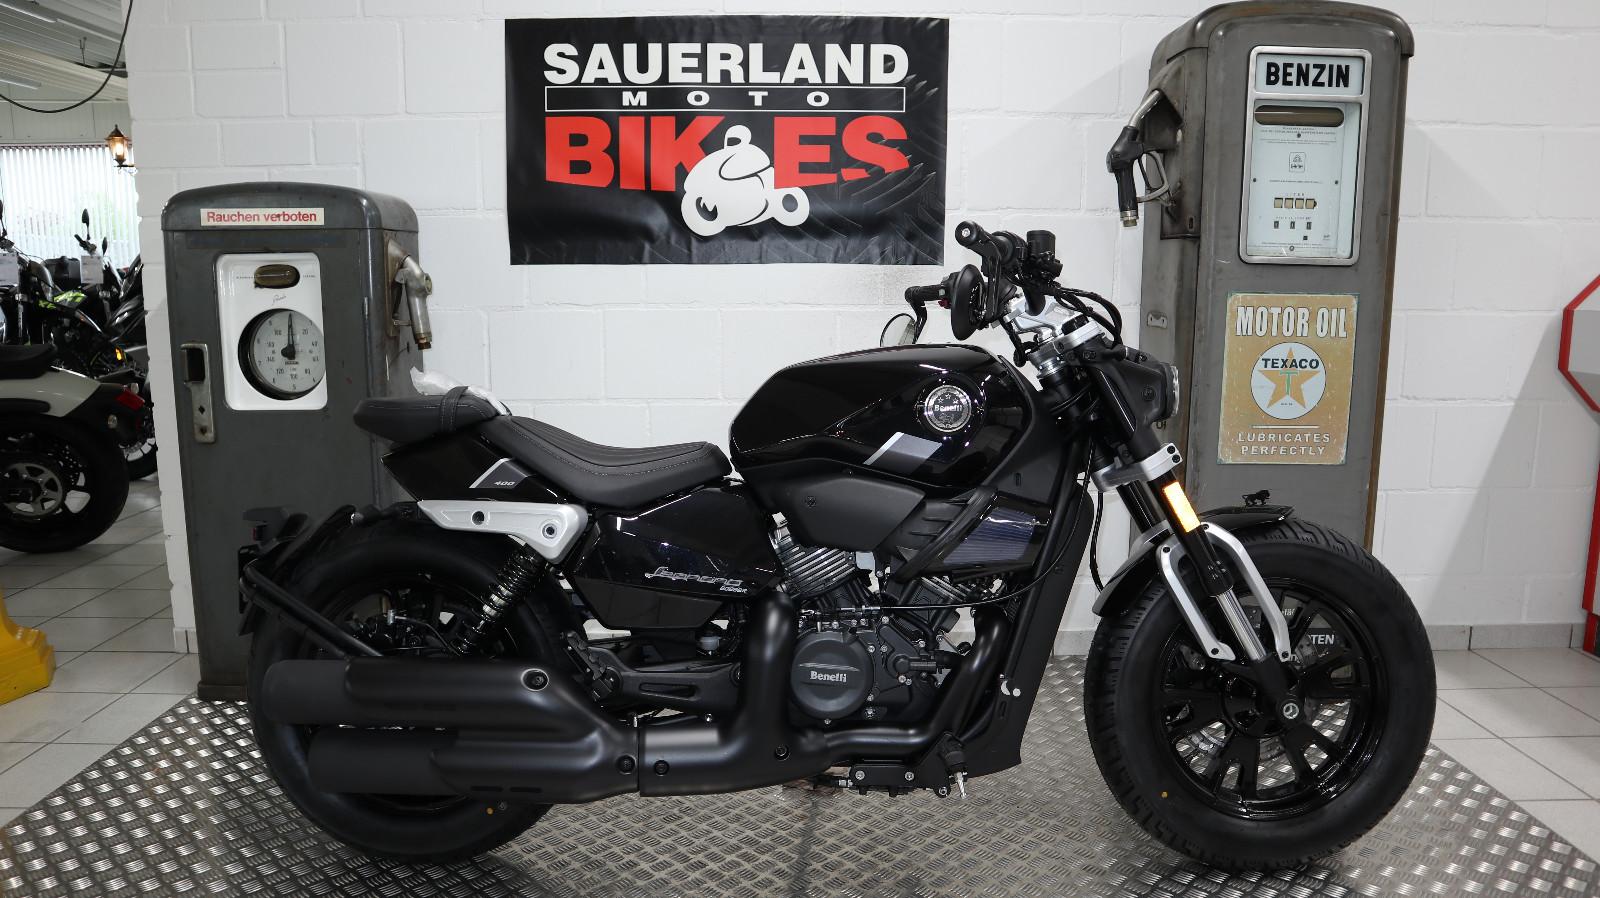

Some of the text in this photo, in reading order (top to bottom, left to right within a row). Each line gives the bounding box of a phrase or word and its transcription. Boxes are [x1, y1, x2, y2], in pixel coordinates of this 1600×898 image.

[543, 43, 909, 84] SAUERLAND
[1266, 62, 1350, 87] BENZIN
[622, 91, 830, 107] MOTO
[206, 211, 317, 222] Rauchen verboten
[1235, 306, 1347, 338] MOTOR OIL
[1261, 358, 1320, 369] TEXACO
[1238, 432, 1330, 443] LUBRICATES
[1241, 445, 1325, 455] PERFECTLY
[1308, 634, 1335, 644] TEN
[810, 670, 847, 682] Benelli
